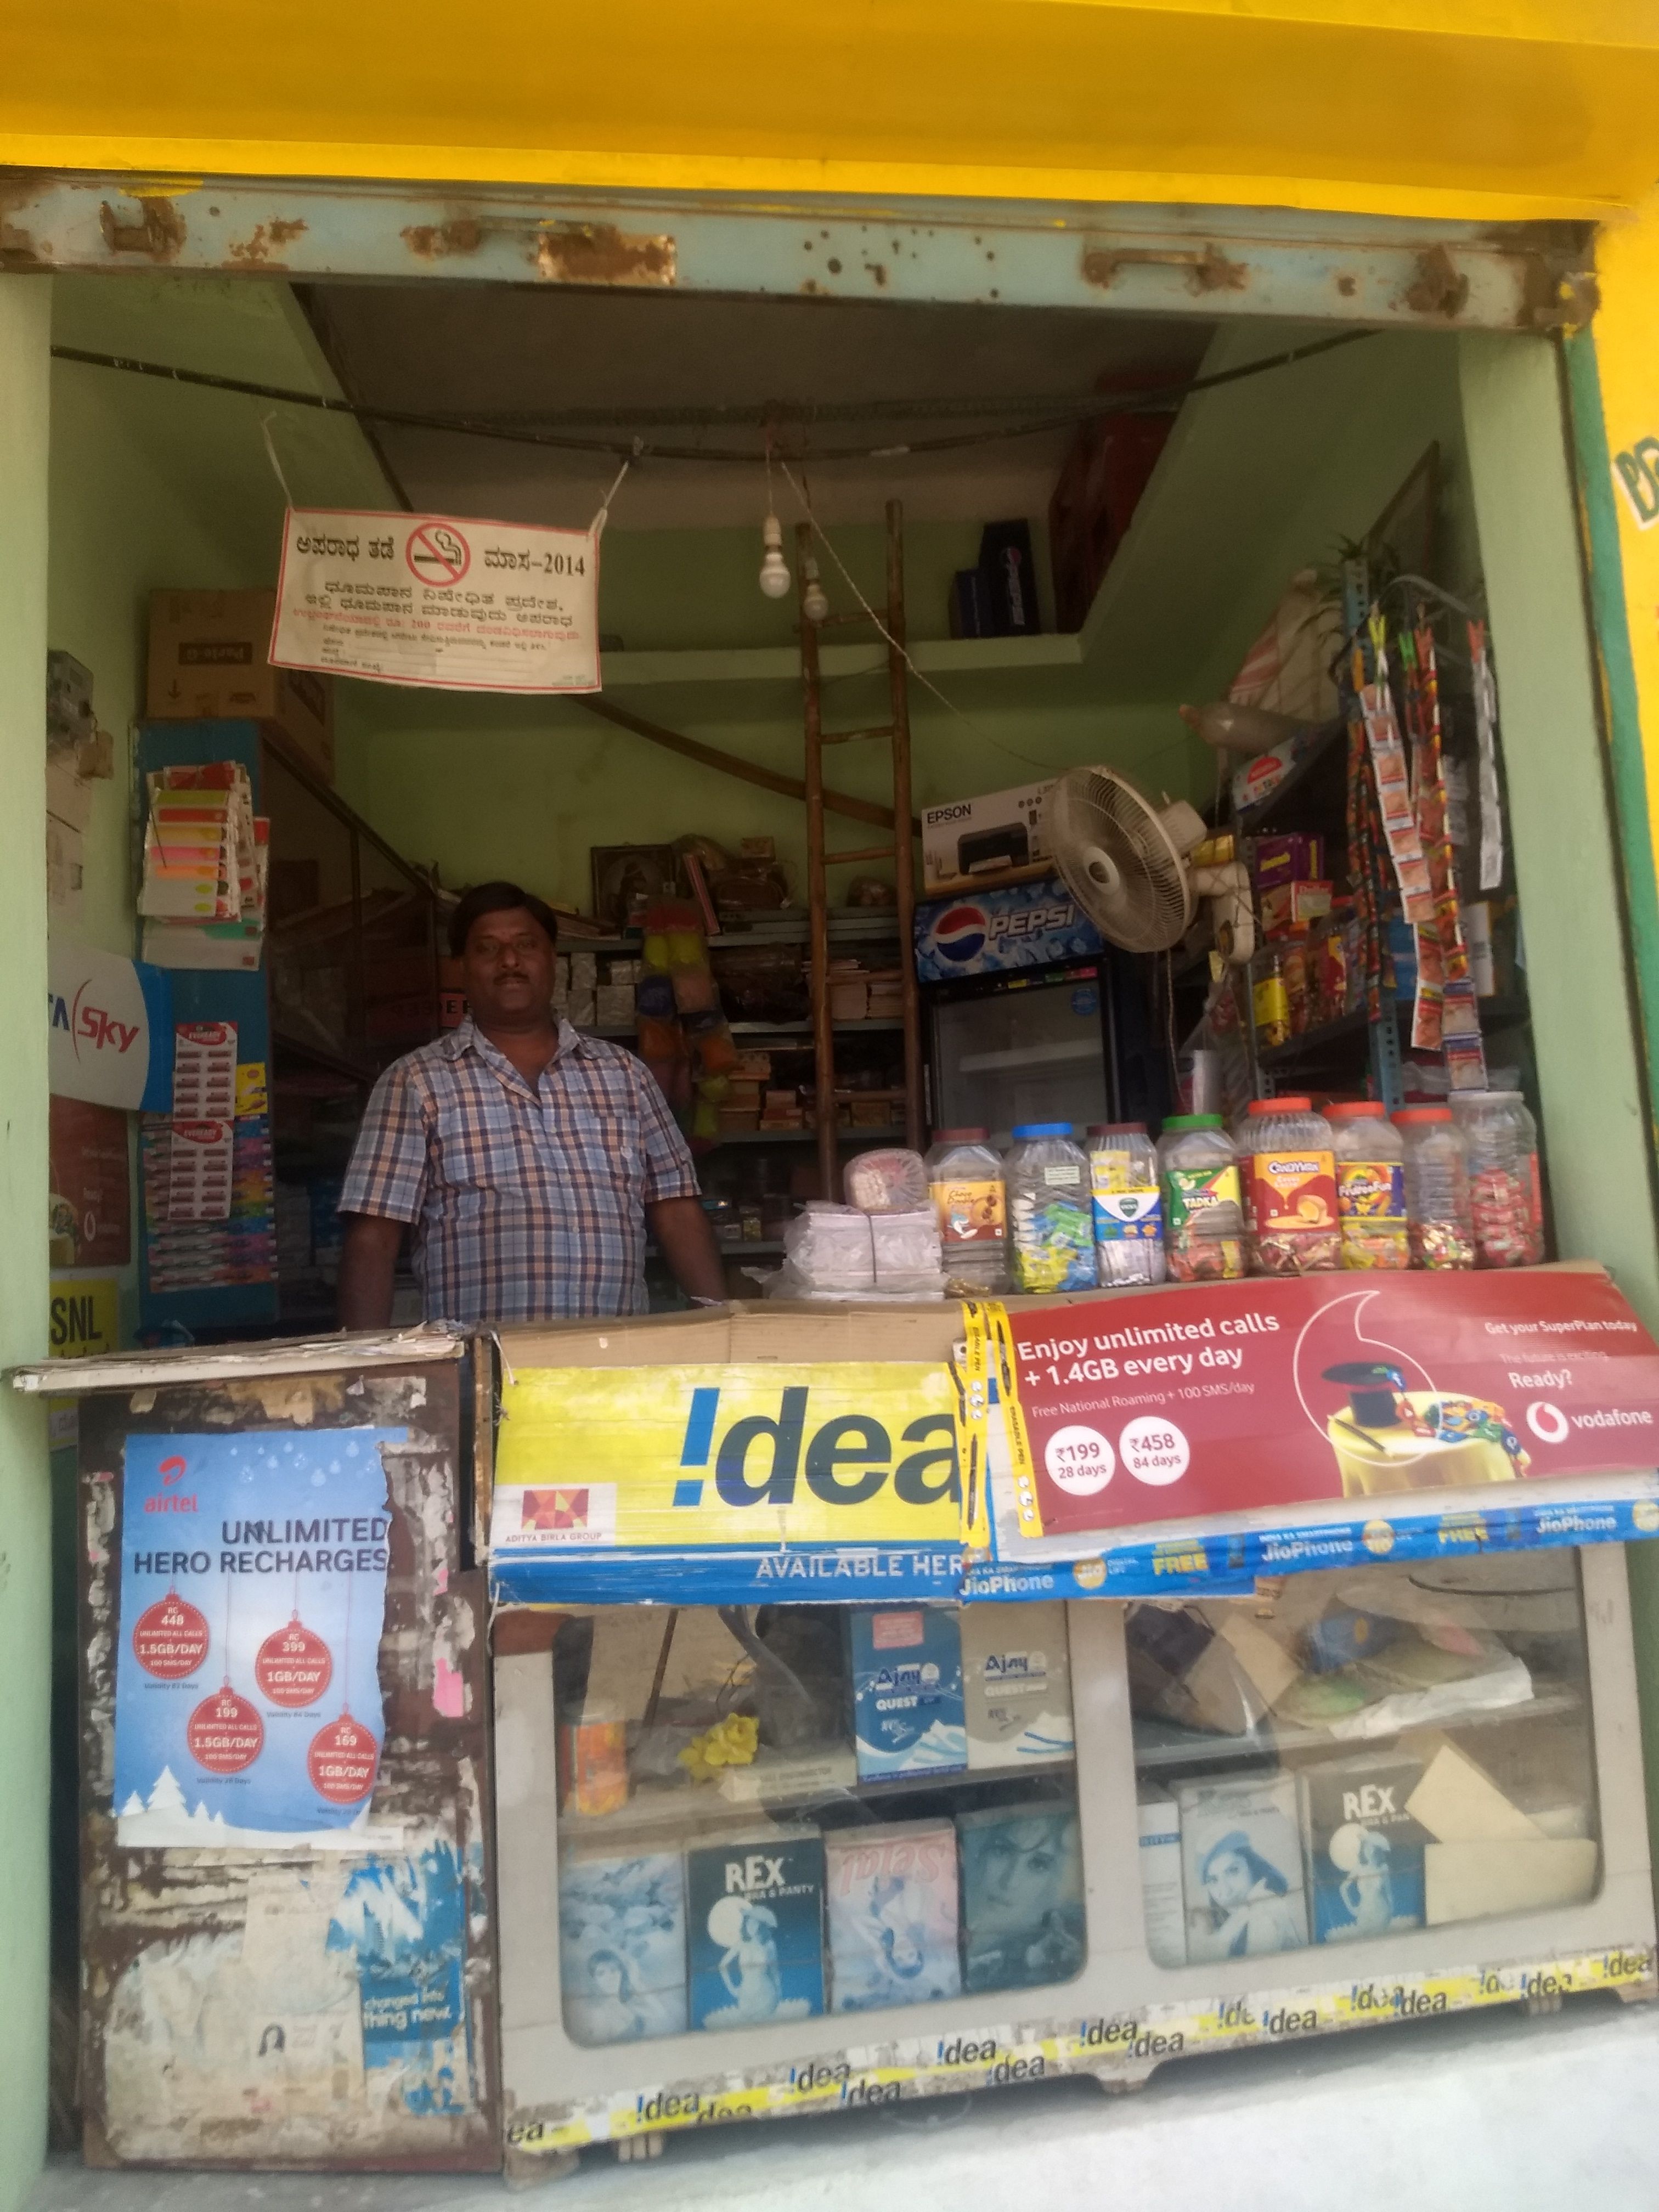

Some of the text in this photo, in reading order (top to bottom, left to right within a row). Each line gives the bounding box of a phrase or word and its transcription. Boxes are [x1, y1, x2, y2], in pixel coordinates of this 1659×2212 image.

[296, 534, 360, 562] ಅಪರಾಧ
[927, 803, 972, 824] EPSON
[988, 904, 1076, 940] PEPSI
[1018, 1311, 1280, 1362] Enjoy unlimited calls
[1485, 1322, 1509, 1334] Get
[1509, 1323, 1538, 1335] your
[1601, 1320, 1638, 1332] today
[1024, 1344, 1244, 1388] + 1.4GB every day
[1508, 1369, 1573, 1390] Ready?
[1031, 1381, 1256, 1419] Free National Roaming + 100 SMS/day
[1571, 1408, 1654, 1429] vodafone
[1055, 1442, 1101, 1463] ₹199
[1128, 1433, 1176, 1453] ₹458
[1058, 1463, 1108, 1480] 28 days
[1133, 1454, 1182, 1471] 84 days
[144, 1493, 198, 1513] airtel
[221, 1517, 389, 1545] UNLIMITED
[1537, 1515, 1617, 1533] JioPhone
[505, 1534, 538, 1543] ADITYA
[569, 1532, 602, 1541] GROUP
[1262, 1540, 1353, 1561] JioPhone
[134, 1549, 387, 1575] HERO RECHARGES
[755, 1554, 904, 1578] AVAILABLE
[1152, 1553, 1208, 1576] FREE
[960, 1574, 1055, 1595] JioPhone
[140, 1644, 203, 1655] 1.5GB/DAY
[267, 1671, 321, 1682] 1GB/DAY
[876, 1696, 918, 1712] QUEST
[194, 1737, 259, 1748] 1.5GB/DAY
[319, 1765, 370, 1778] 1GB/DAY
[1342, 1784, 1396, 1820] REX
[725, 1855, 786, 1893] REX
